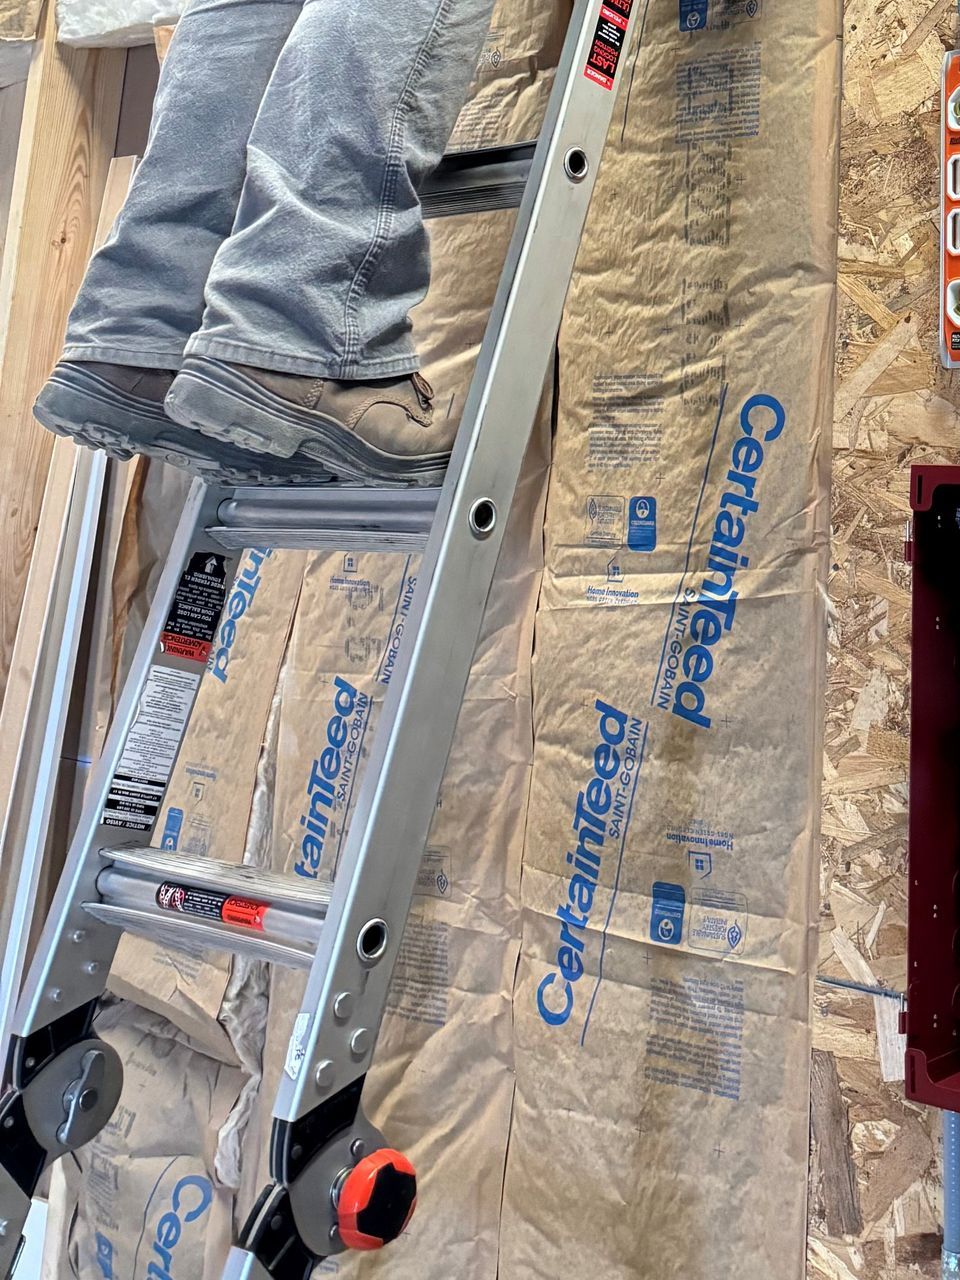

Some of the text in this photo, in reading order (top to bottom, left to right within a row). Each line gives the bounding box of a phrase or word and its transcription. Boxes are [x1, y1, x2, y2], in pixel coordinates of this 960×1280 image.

[591, 53, 615, 73] LAST
[178, 603, 200, 613] BALANCE
[587, 585, 639, 598] Home Innovation
[672, 393, 786, 729] CertainTeed
[656, 586, 697, 710] SAINT-GOBAIN
[337, 692, 368, 802] SAINT-GOBAIN
[609, 717, 642, 839] SAINT-GOBAIN
[536, 699, 628, 1026] CertainTeed
[666, 832, 734, 851] Home Innovation
